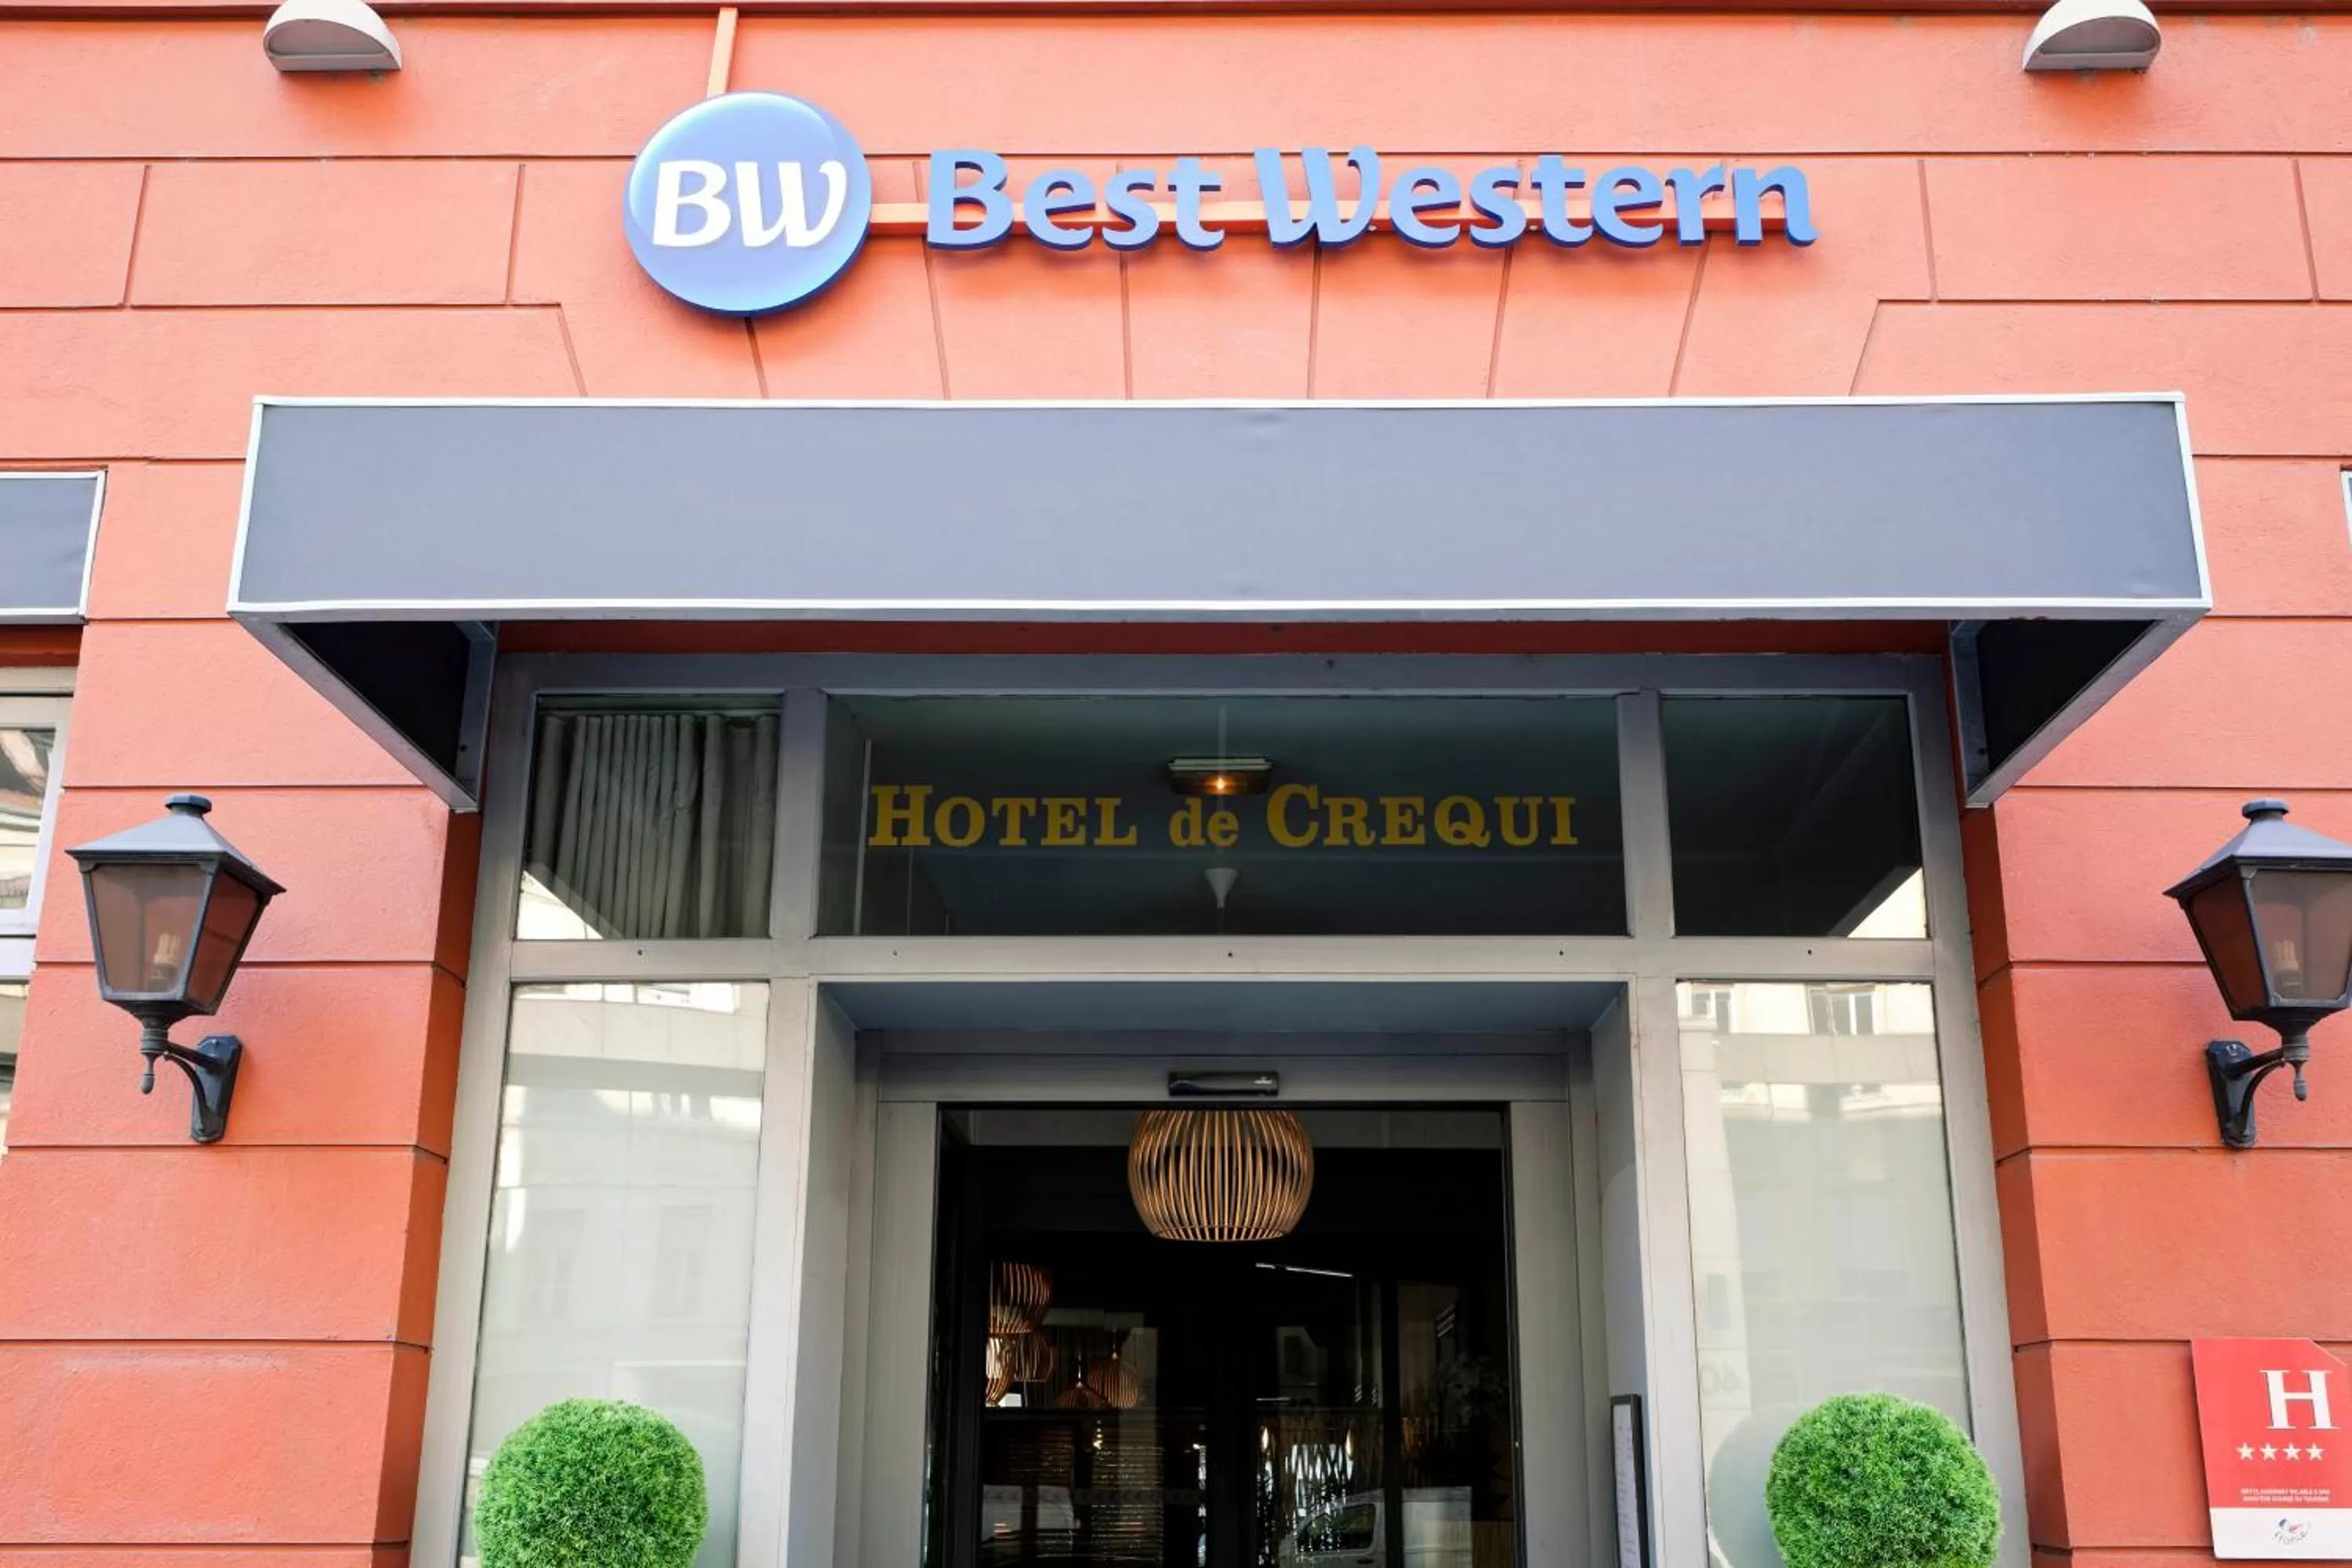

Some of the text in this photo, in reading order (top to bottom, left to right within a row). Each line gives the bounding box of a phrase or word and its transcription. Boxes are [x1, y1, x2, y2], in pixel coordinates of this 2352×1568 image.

[653, 160, 848, 247] BW
[925, 145, 1820, 250] Best Western
[868, 783, 1579, 848] HOTEL de CREQUI
[2259, 1369, 2339, 1430] H
